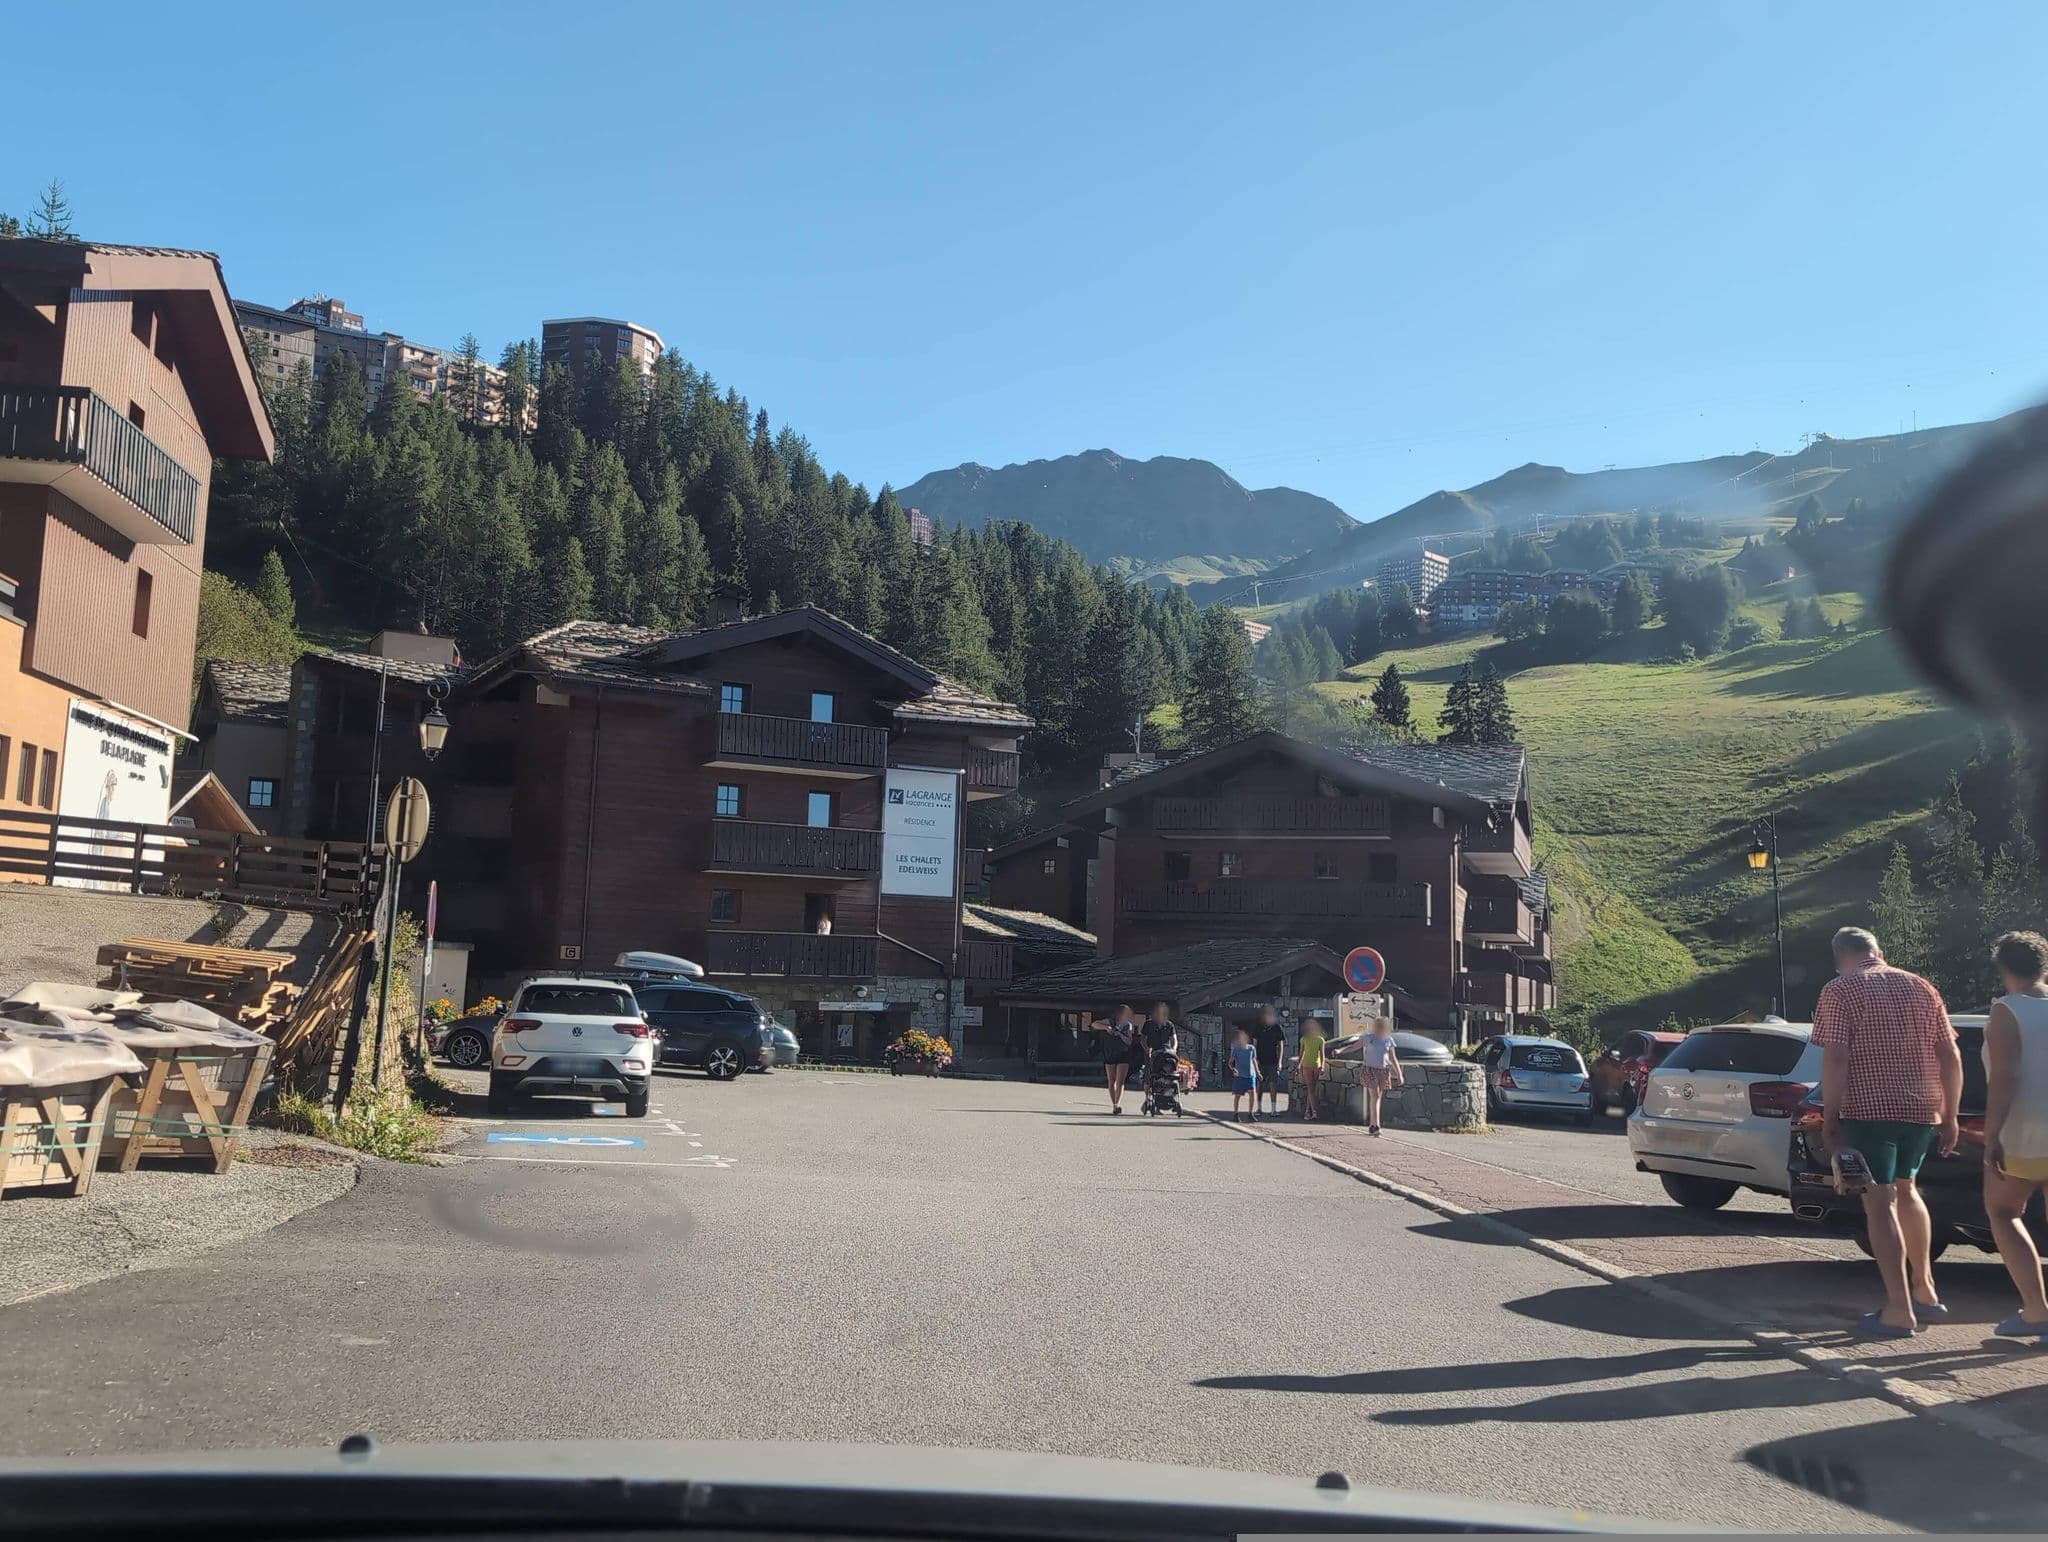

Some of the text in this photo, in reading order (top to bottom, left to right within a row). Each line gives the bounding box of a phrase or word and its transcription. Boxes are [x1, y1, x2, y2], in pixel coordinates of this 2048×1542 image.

[906, 789, 953, 802] LAGRANGE
[896, 855, 942, 865] LES CHALETS
[898, 865, 938, 875] EDELWEISS
